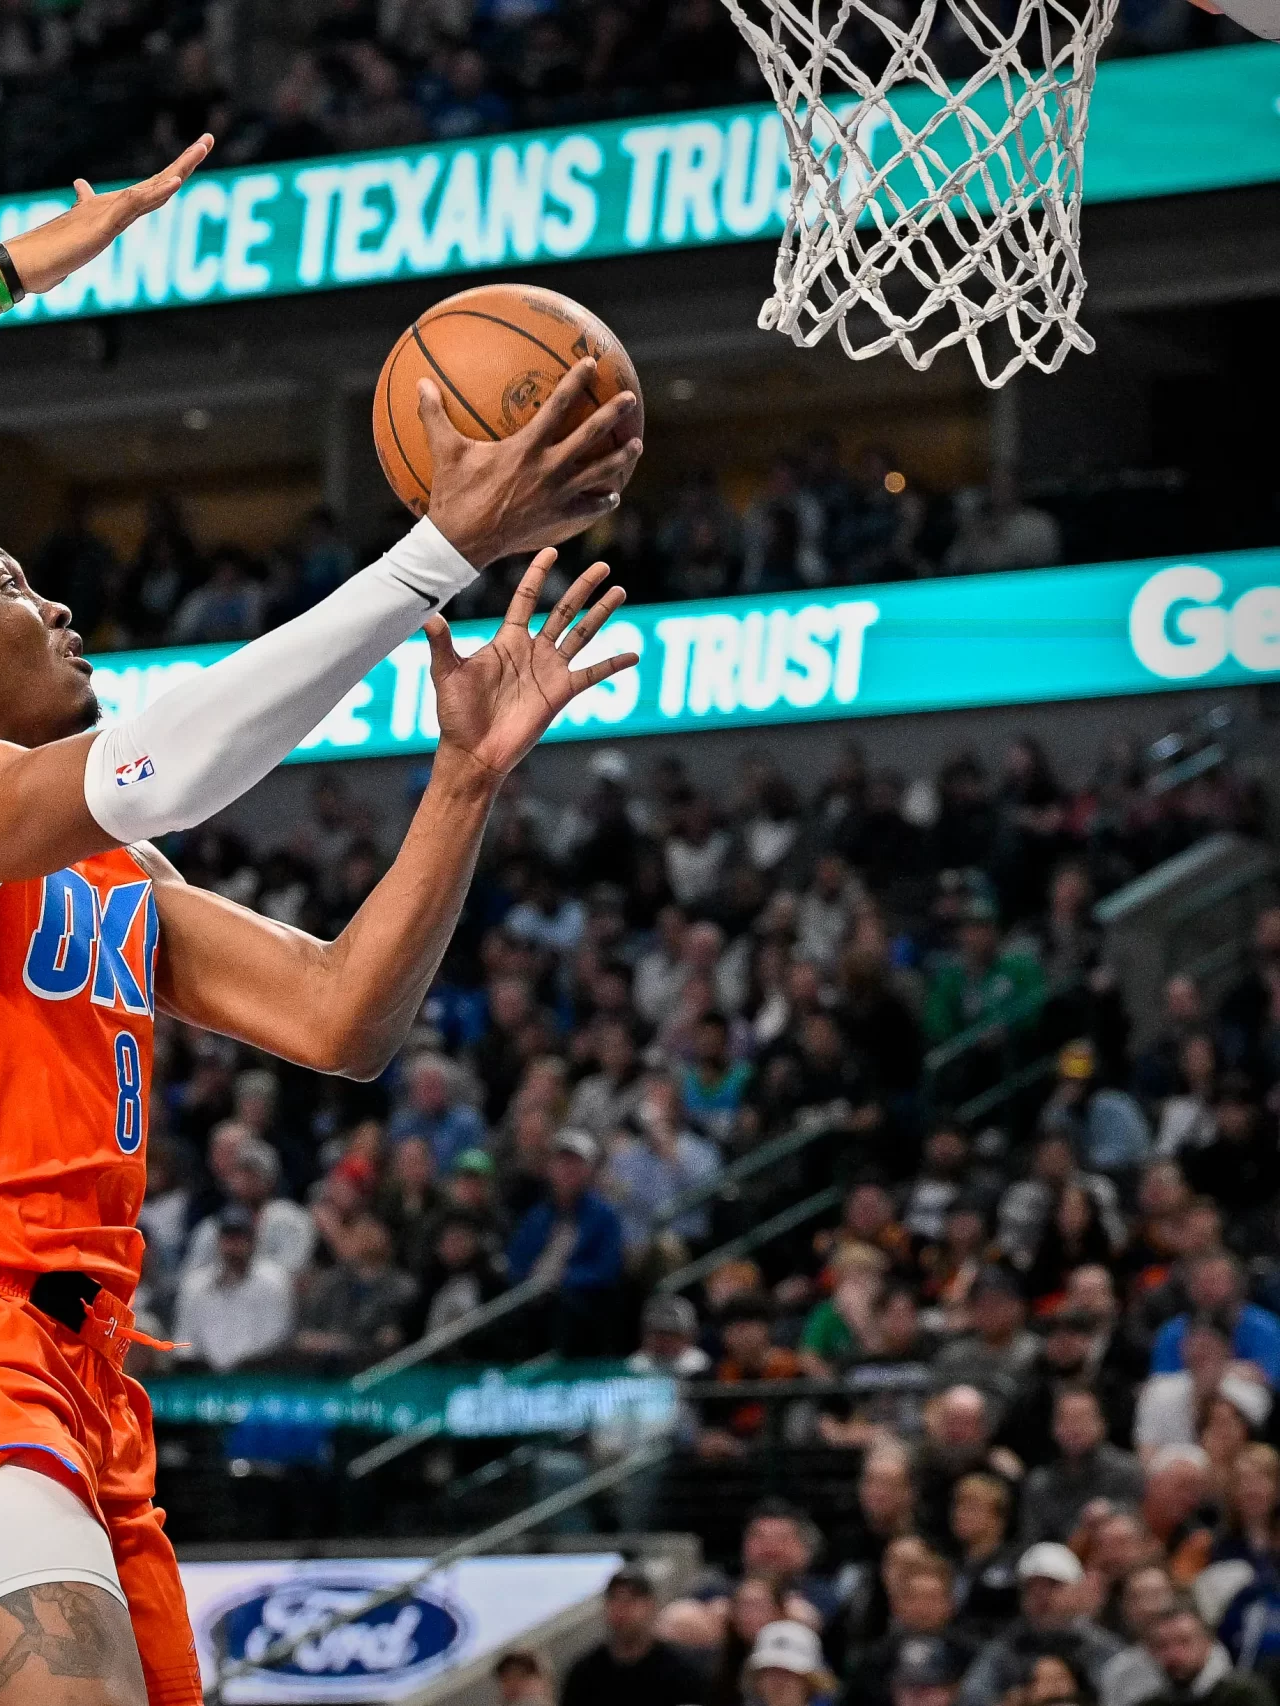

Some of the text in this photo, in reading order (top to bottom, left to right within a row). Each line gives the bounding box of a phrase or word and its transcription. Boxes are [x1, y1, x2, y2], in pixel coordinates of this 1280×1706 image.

[295, 124, 602, 286] TEXANS
[622, 102, 888, 246] TRUST
[655, 601, 880, 718] TRUST
[114, 1030, 143, 1155] 8
[245, 1583, 422, 1675] Ford
